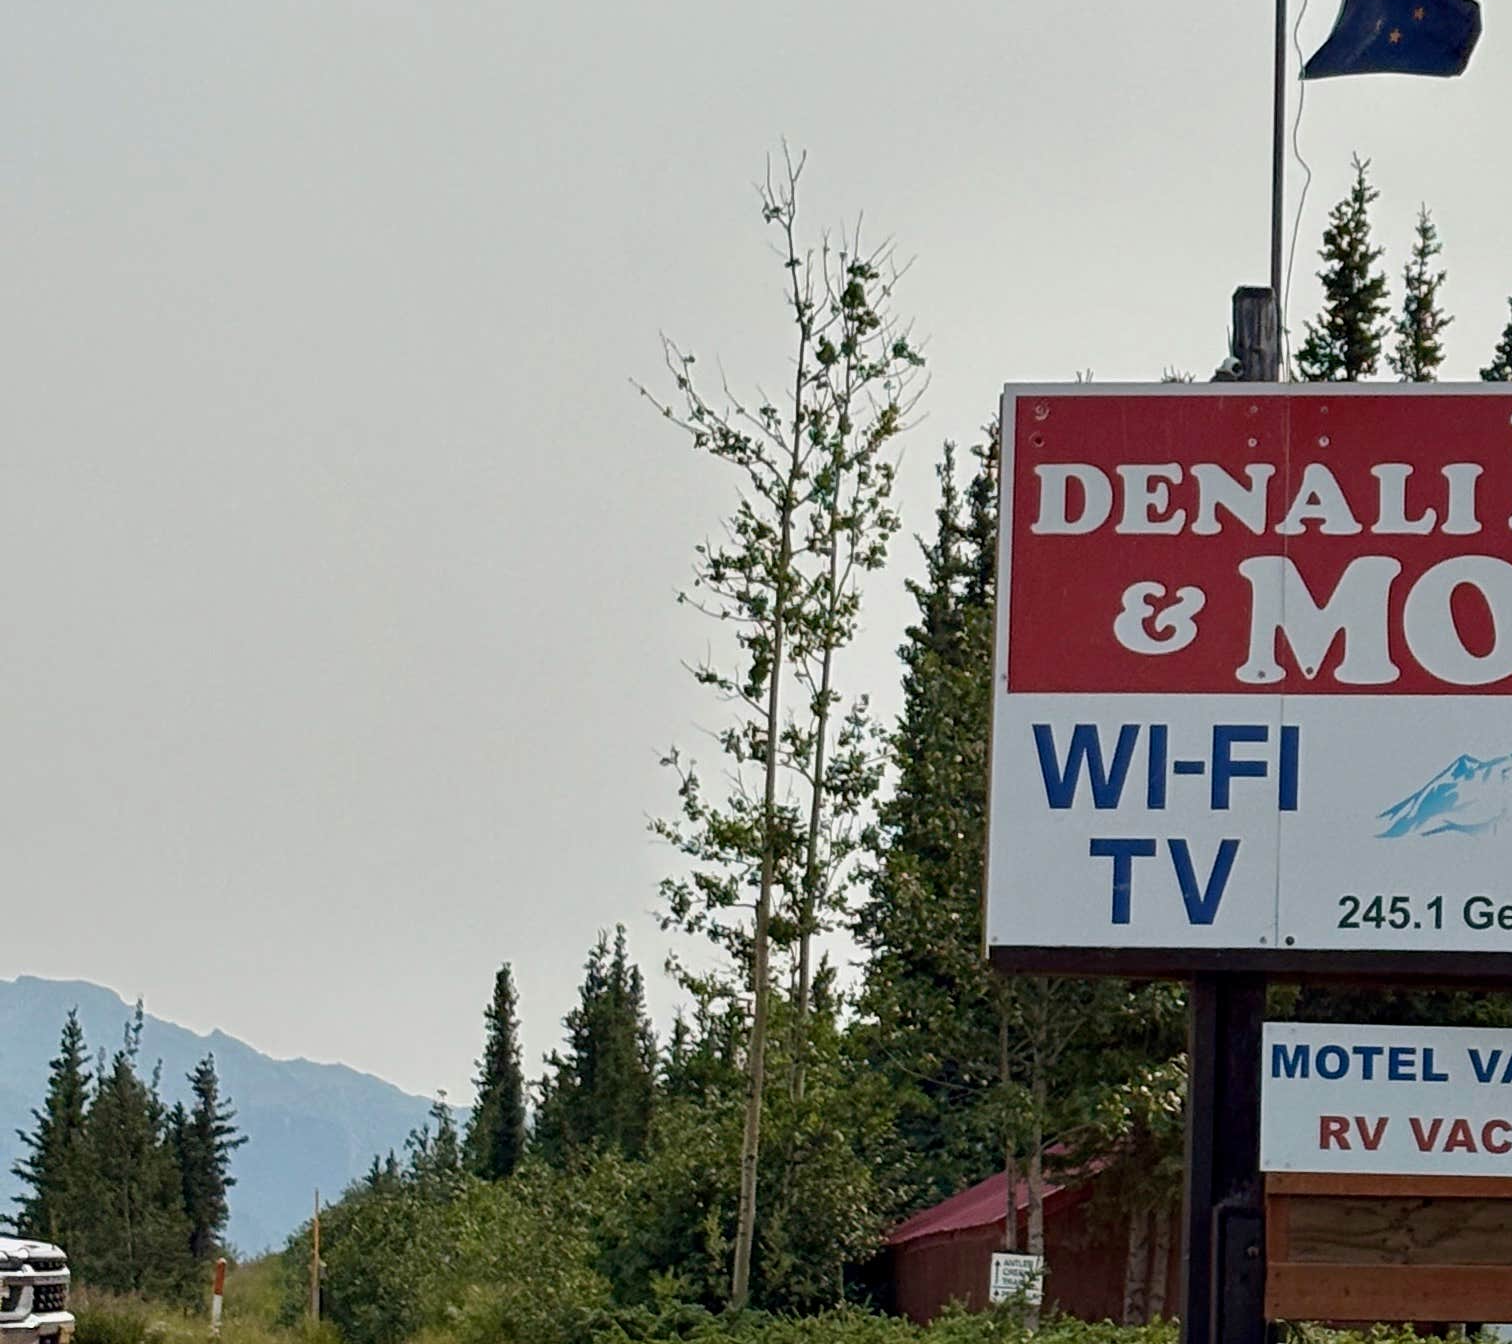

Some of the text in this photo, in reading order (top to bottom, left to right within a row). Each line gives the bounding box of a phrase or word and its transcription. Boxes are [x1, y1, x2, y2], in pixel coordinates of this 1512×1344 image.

[1031, 463, 1483, 535] DENALI
[1114, 582, 1205, 654] &
[1033, 724, 1299, 812] WI-FI
[1089, 838, 1240, 925] TV
[1338, 896, 1443, 930] 245.1
[1272, 1044, 1449, 1082] MOTEL
[1319, 1115, 1389, 1150] RV
